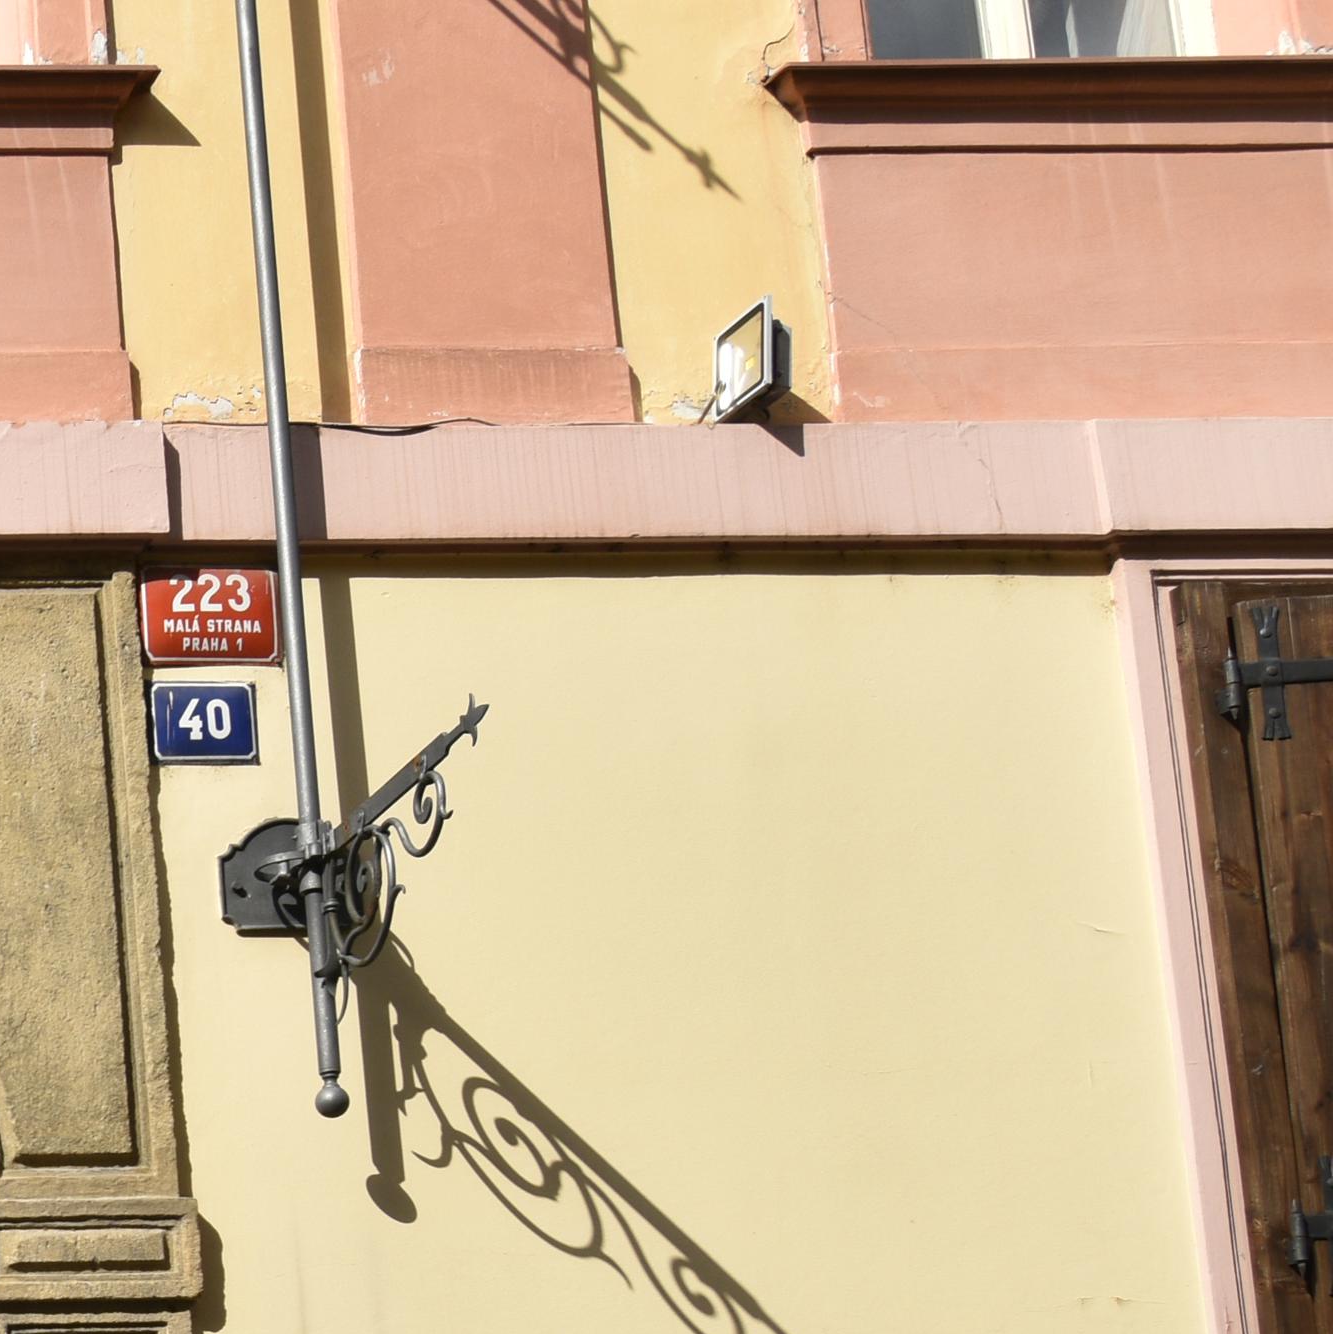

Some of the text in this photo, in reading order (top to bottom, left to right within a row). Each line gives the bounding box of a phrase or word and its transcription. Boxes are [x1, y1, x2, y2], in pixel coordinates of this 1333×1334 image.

[169, 574, 251, 612] 223
[164, 615, 262, 634] MALÁ STRANA
[183, 637, 244, 652] PRAHA 1
[178, 698, 232, 741] 40
